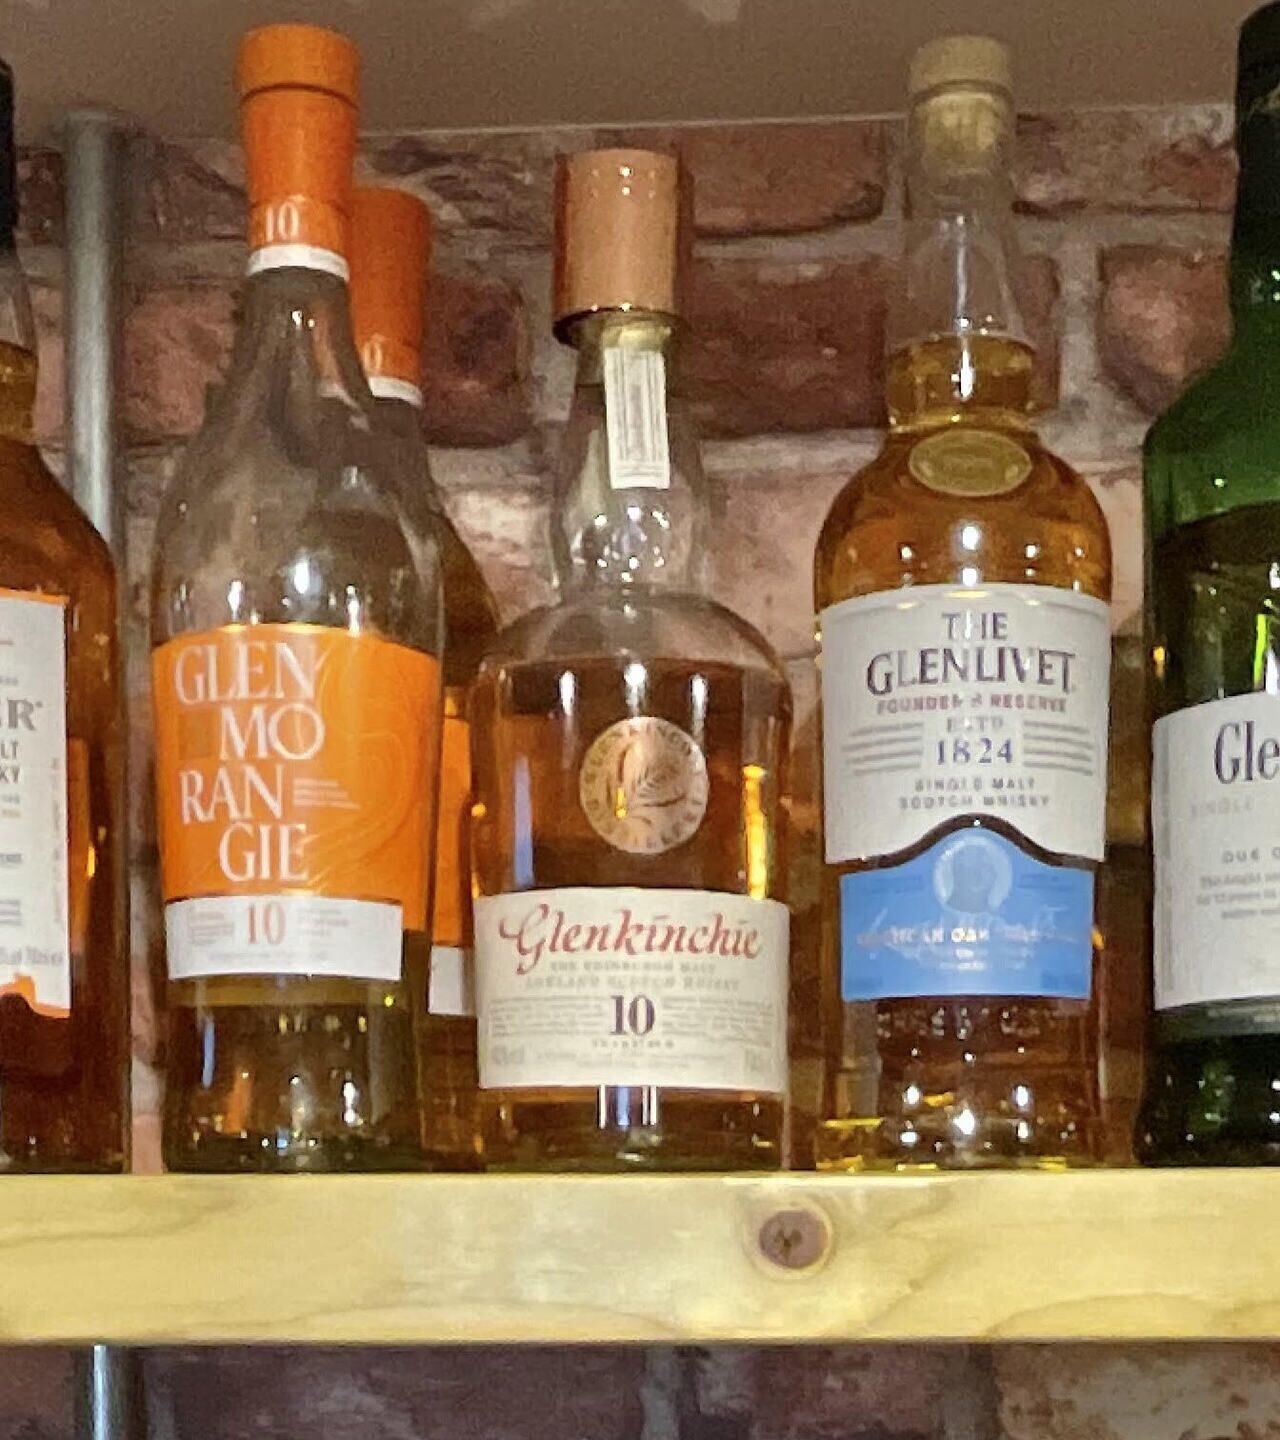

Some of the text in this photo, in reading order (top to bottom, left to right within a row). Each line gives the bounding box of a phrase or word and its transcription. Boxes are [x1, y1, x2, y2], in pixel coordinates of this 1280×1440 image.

[265, 201, 300, 242] 10
[362, 339, 383, 375] 0
[940, 611, 1008, 642] THE
[175, 640, 317, 706] GLEN
[866, 646, 1077, 697] GLENLIVET
[221, 703, 326, 762] MO
[935, 736, 1013, 766] 1824
[180, 764, 284, 824] RAN
[220, 823, 311, 882] GIE
[246, 902, 287, 946] 10
[499, 903, 764, 976] Glenkinchie
[609, 993, 657, 1037] 10
